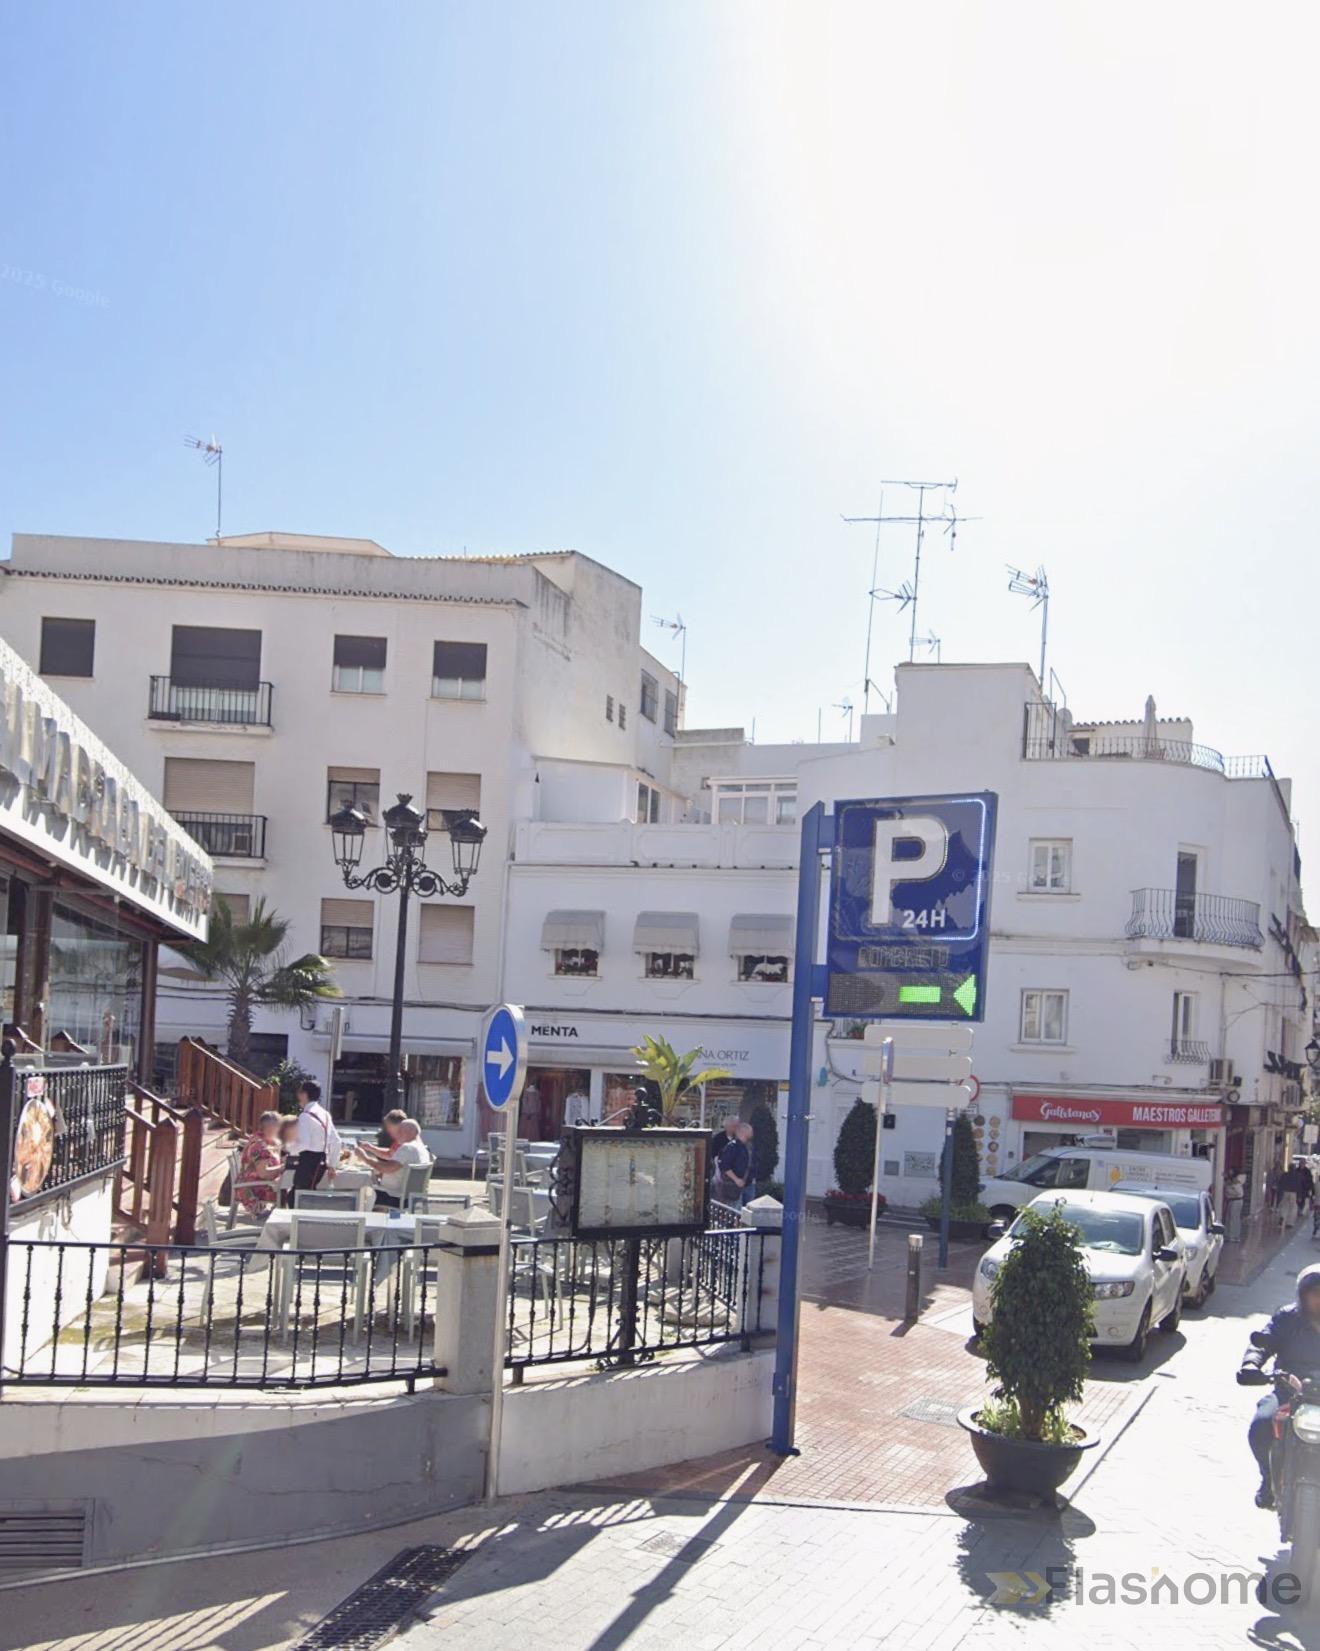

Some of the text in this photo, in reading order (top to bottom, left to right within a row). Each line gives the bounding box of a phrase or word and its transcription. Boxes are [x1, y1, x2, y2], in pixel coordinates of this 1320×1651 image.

[871, 815, 949, 926] P
[902, 909, 946, 929] 24H
[531, 1024, 578, 1038] MENTA
[717, 1049, 750, 1061] ORTIZ
[1132, 1106, 1187, 1123] MAESTROS
